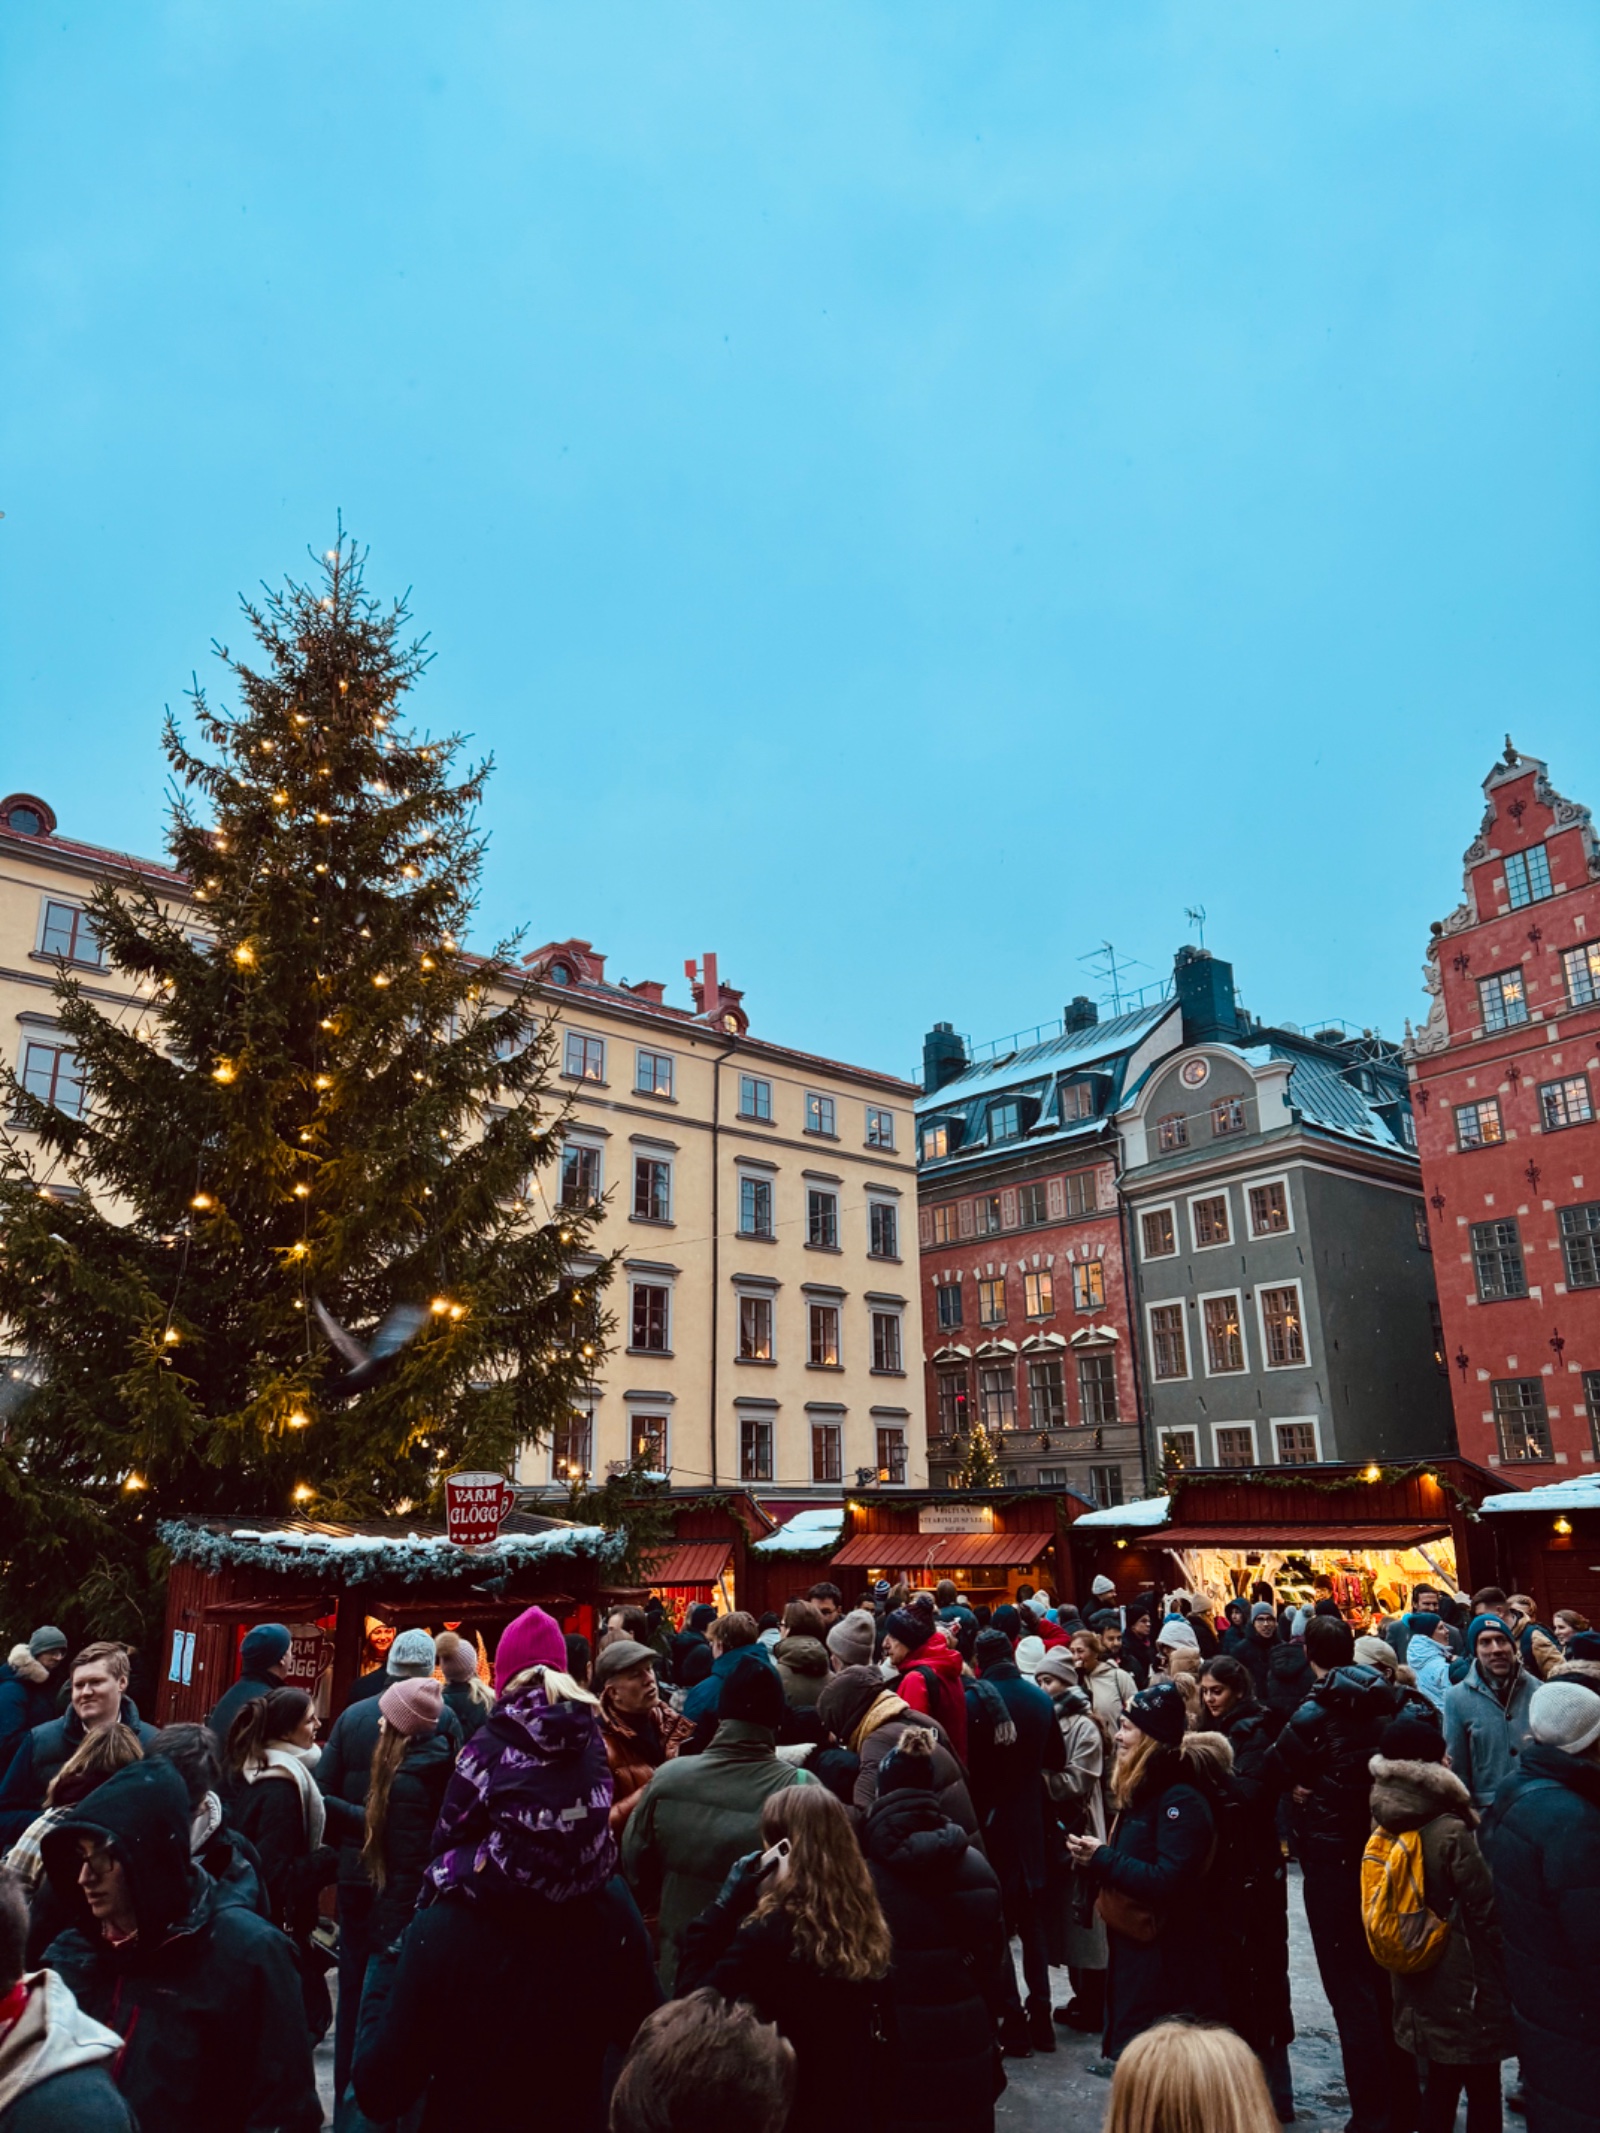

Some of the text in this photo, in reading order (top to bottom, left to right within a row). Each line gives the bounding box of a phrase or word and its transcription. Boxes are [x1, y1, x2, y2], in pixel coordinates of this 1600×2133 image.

[454, 1489, 497, 1503] VARM
[450, 1503, 499, 1524] GLÖGG
[293, 1640, 315, 1654] RM
